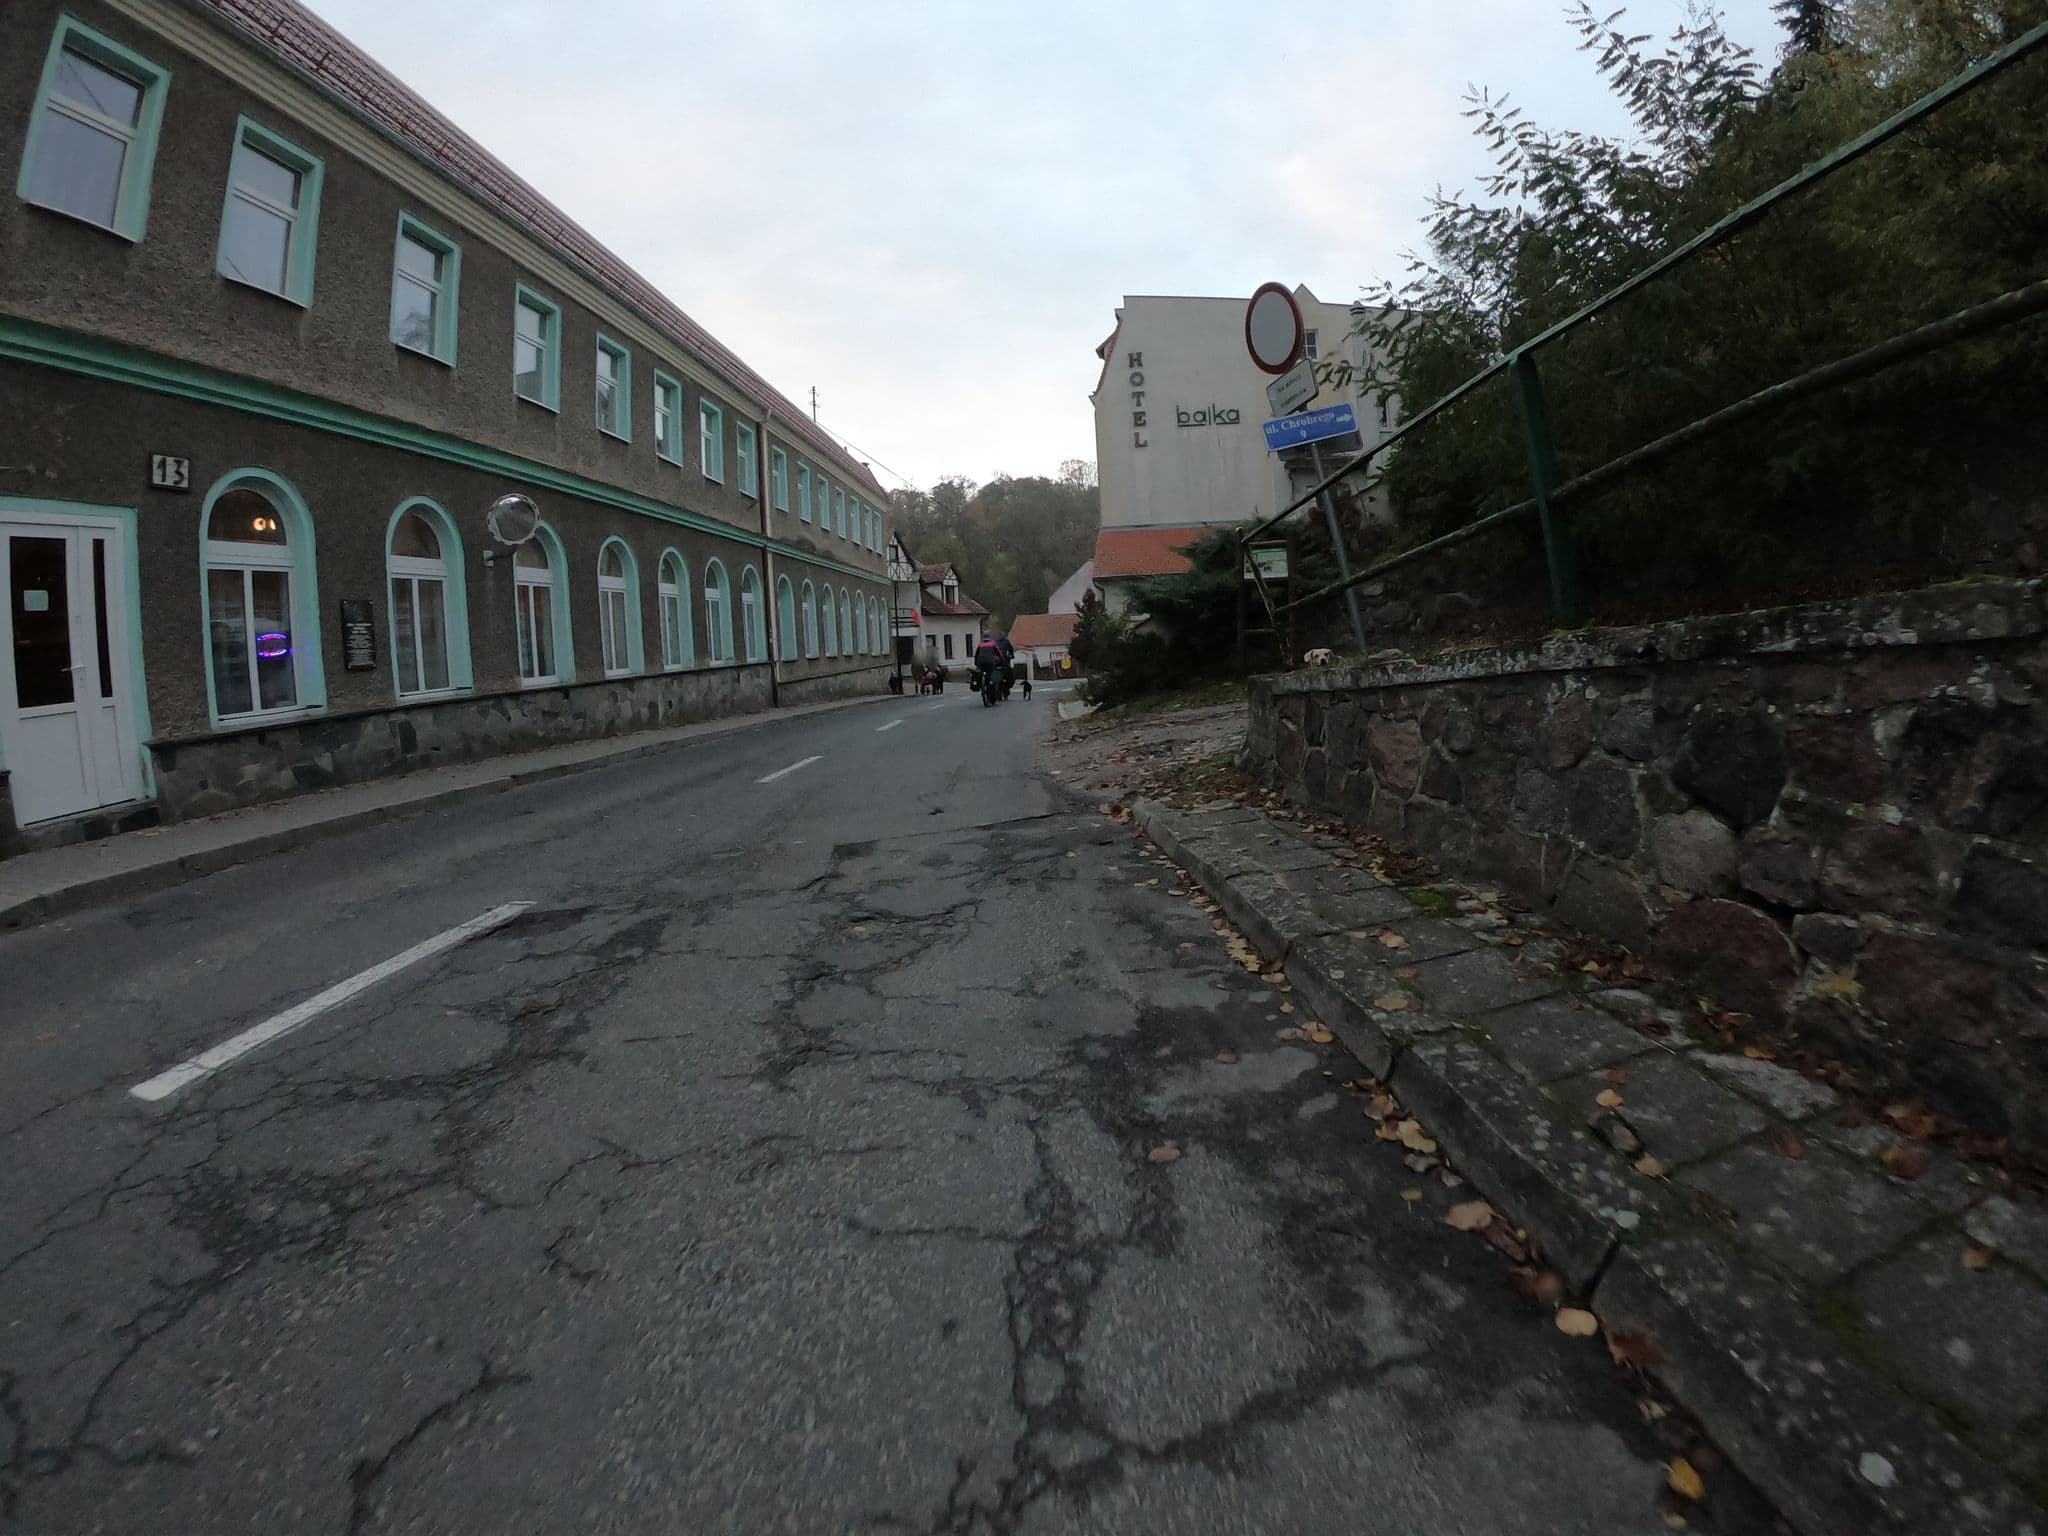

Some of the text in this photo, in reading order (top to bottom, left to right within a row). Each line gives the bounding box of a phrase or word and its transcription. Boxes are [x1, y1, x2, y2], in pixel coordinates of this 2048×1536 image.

[1128, 352, 1148, 448] HOTEL
[1265, 412, 1335, 434] ul. Chrobrego
[1300, 430, 1307, 440] 9
[157, 457, 185, 485] 13
